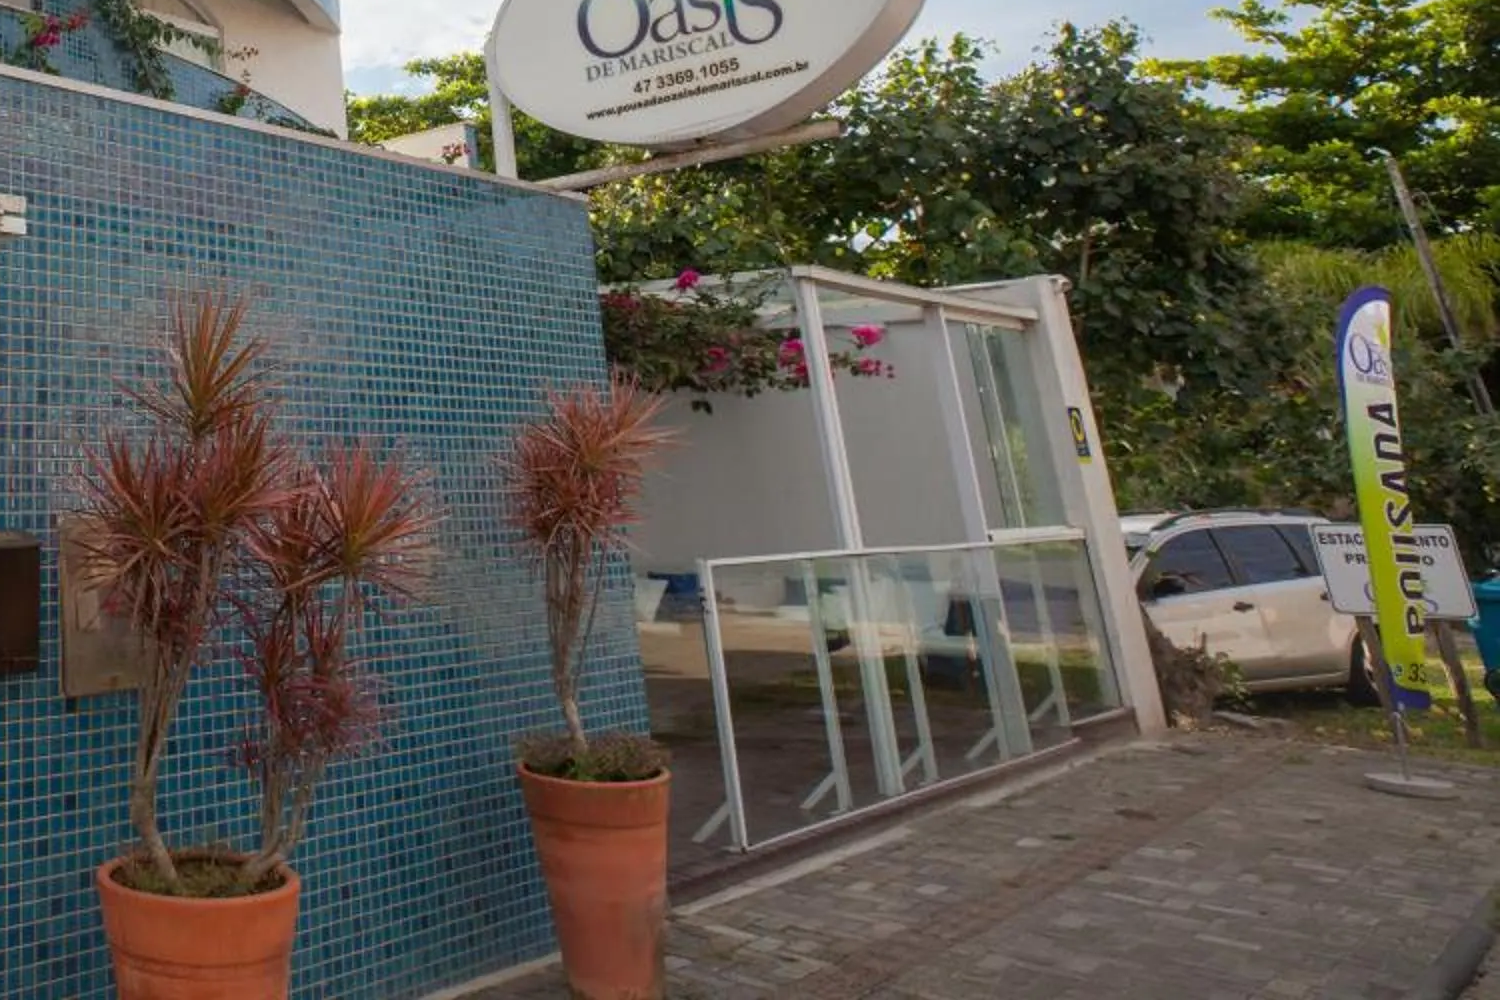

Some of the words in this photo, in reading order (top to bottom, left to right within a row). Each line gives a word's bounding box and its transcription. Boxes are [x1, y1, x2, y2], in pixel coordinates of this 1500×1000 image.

[585, 60, 615, 82] DE
[618, 31, 735, 74] MARISCAL
[633, 79, 651, 94] 47
[656, 57, 740, 90] 3369.1055
